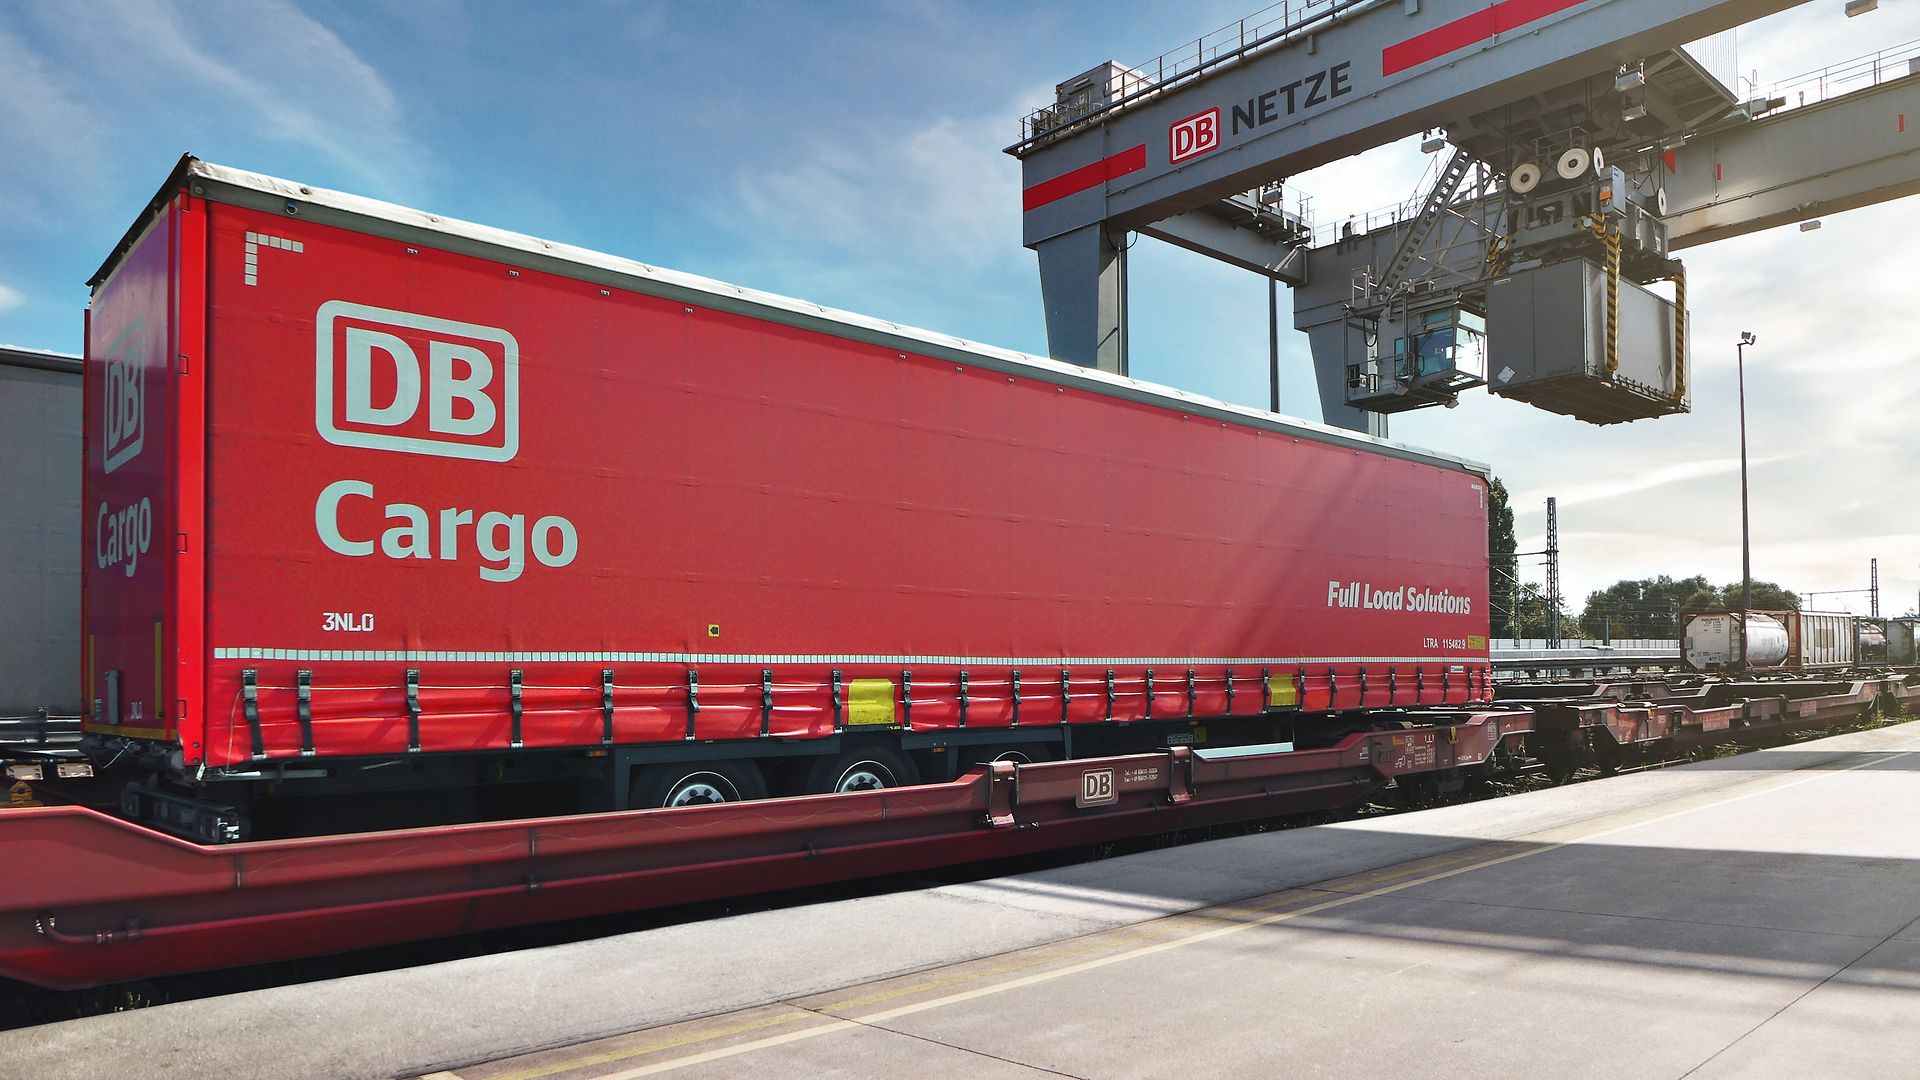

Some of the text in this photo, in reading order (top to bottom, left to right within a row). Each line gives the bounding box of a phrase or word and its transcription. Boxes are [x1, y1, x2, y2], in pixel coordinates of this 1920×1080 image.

[1175, 60, 1353, 157] DB NETZE
[108, 345, 140, 451] DB
[346, 326, 497, 436] DB
[97, 496, 152, 578] Cargo
[315, 479, 579, 583] Cargo
[1327, 580, 1471, 615] Full Load Solutions
[1423, 637, 1439, 649] LTRA
[1086, 774, 1111, 798] DB
